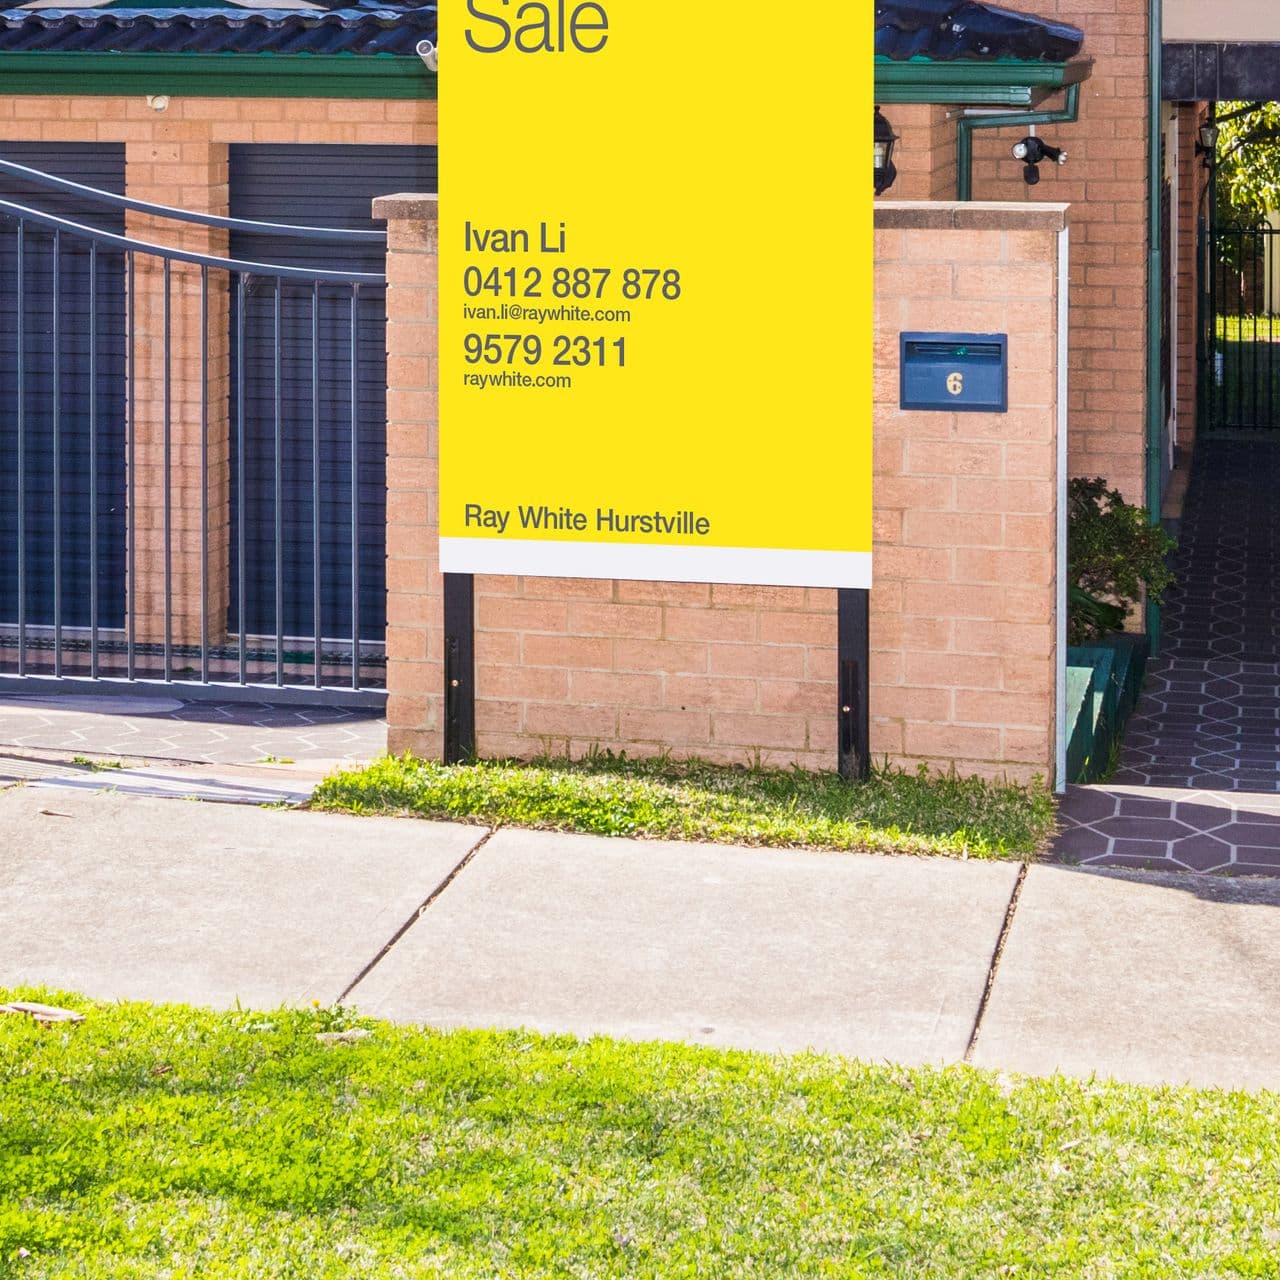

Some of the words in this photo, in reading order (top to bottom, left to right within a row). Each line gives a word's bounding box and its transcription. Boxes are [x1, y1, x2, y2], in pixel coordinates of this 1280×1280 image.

[464, 221, 529, 253] Ivan
[540, 222, 566, 253] Li
[463, 265, 542, 298] 0412
[551, 267, 611, 299] 887
[622, 268, 681, 300] 878
[463, 304, 631, 325] ivan.li@raywhite.com
[463, 333, 542, 365] 9579
[552, 335, 625, 367] 2311
[463, 370, 571, 390] raywhite.com
[946, 372, 963, 395] 6
[464, 503, 510, 534] Ray
[518, 505, 588, 532] White
[596, 508, 711, 535] Hurstville
